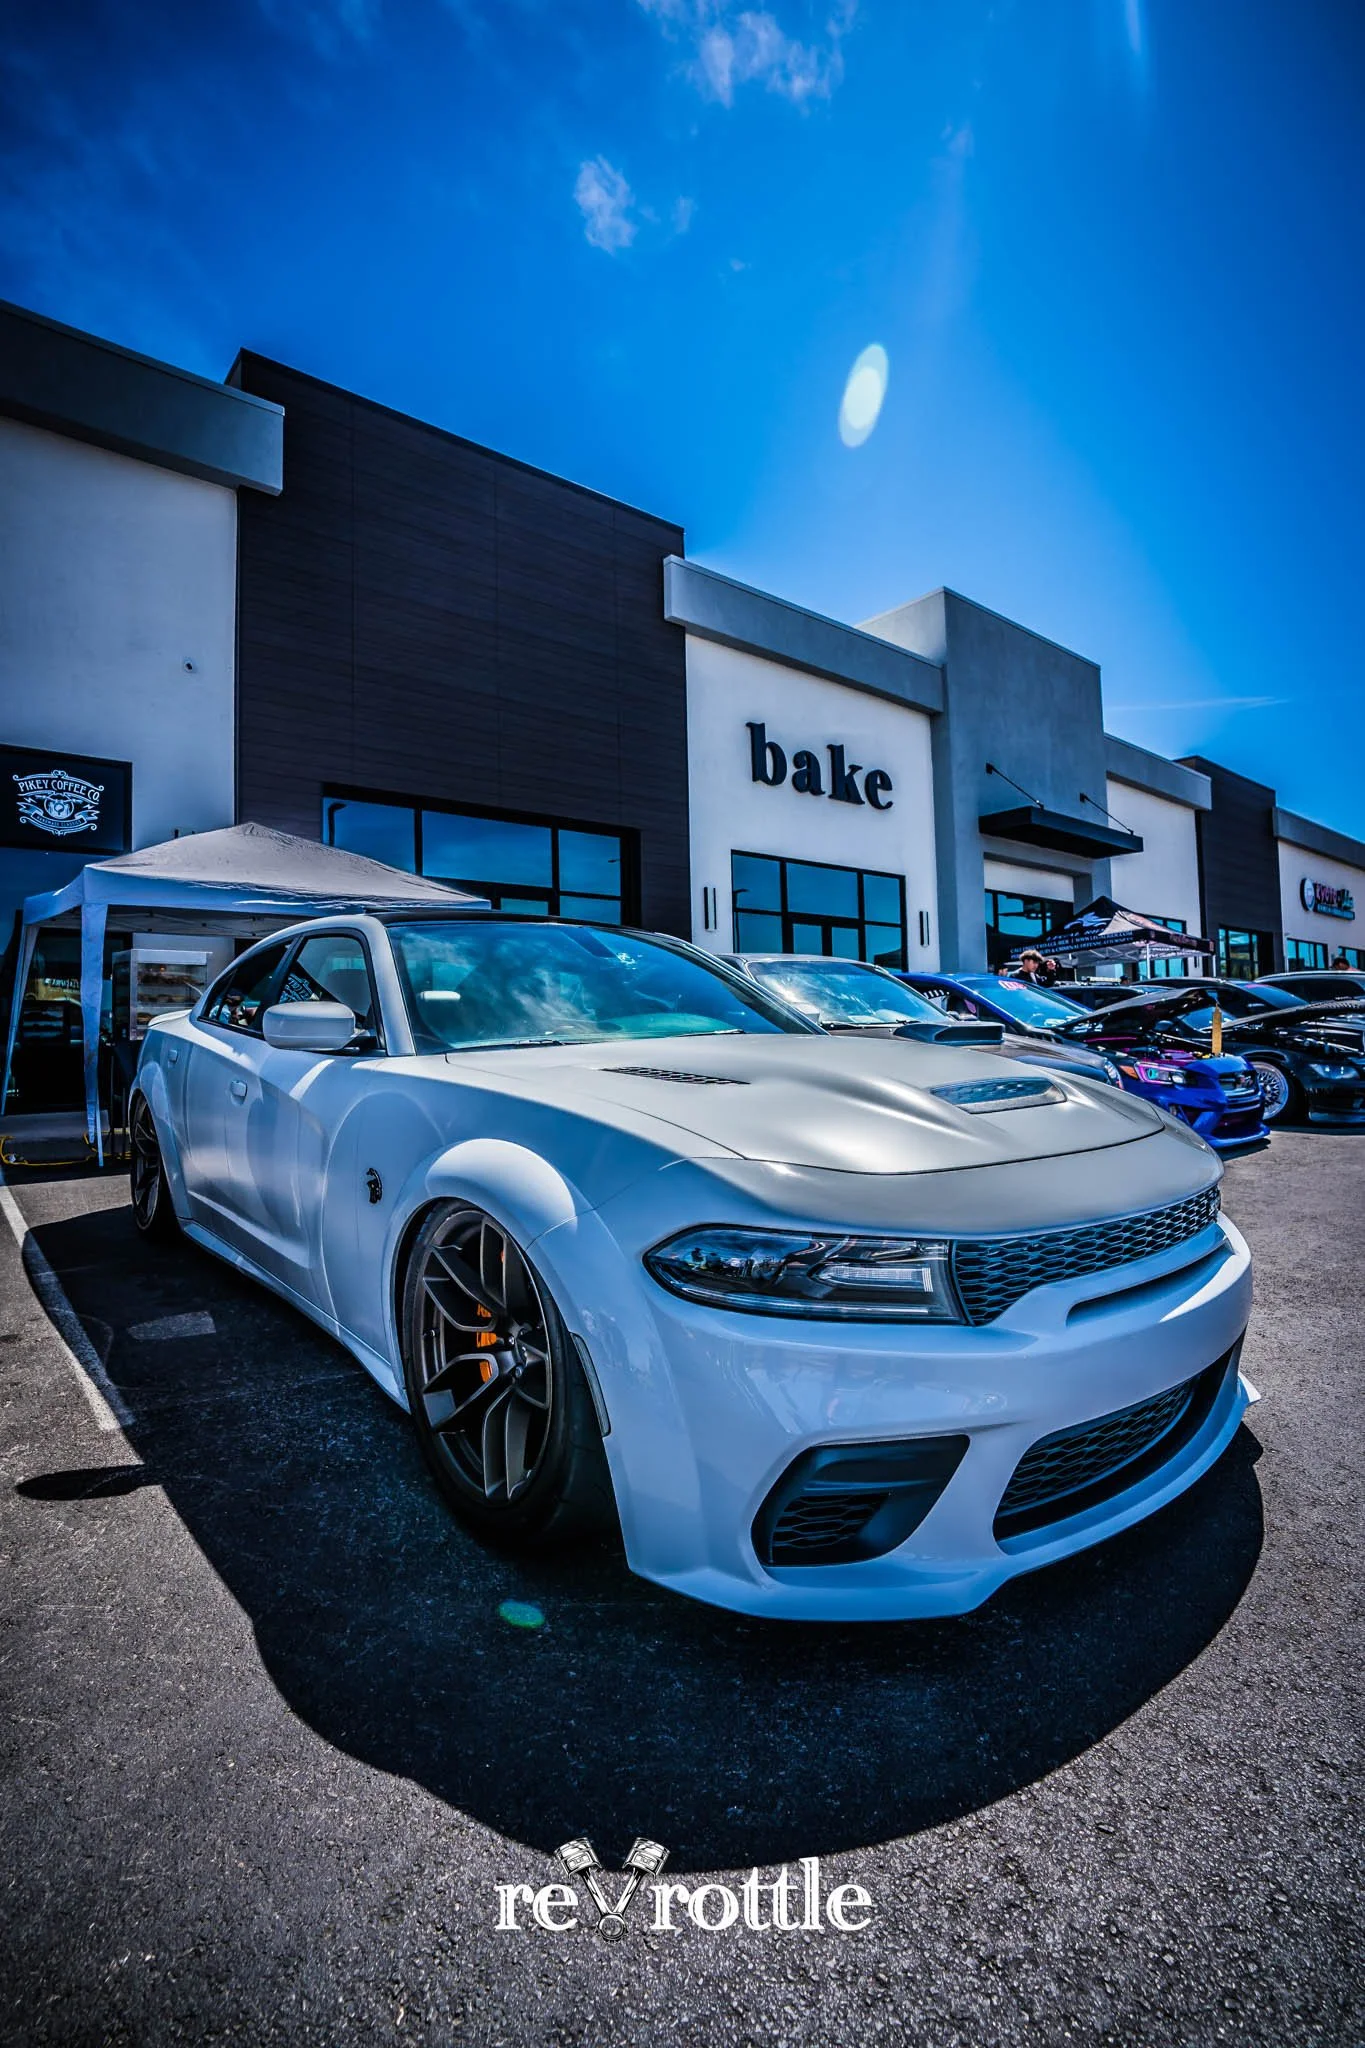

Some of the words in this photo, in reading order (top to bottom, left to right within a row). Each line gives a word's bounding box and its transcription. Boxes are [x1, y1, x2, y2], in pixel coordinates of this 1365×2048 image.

[18, 779, 49, 792] PIKEY
[51, 779, 86, 796] COFFEE
[745, 721, 894, 810] bake
